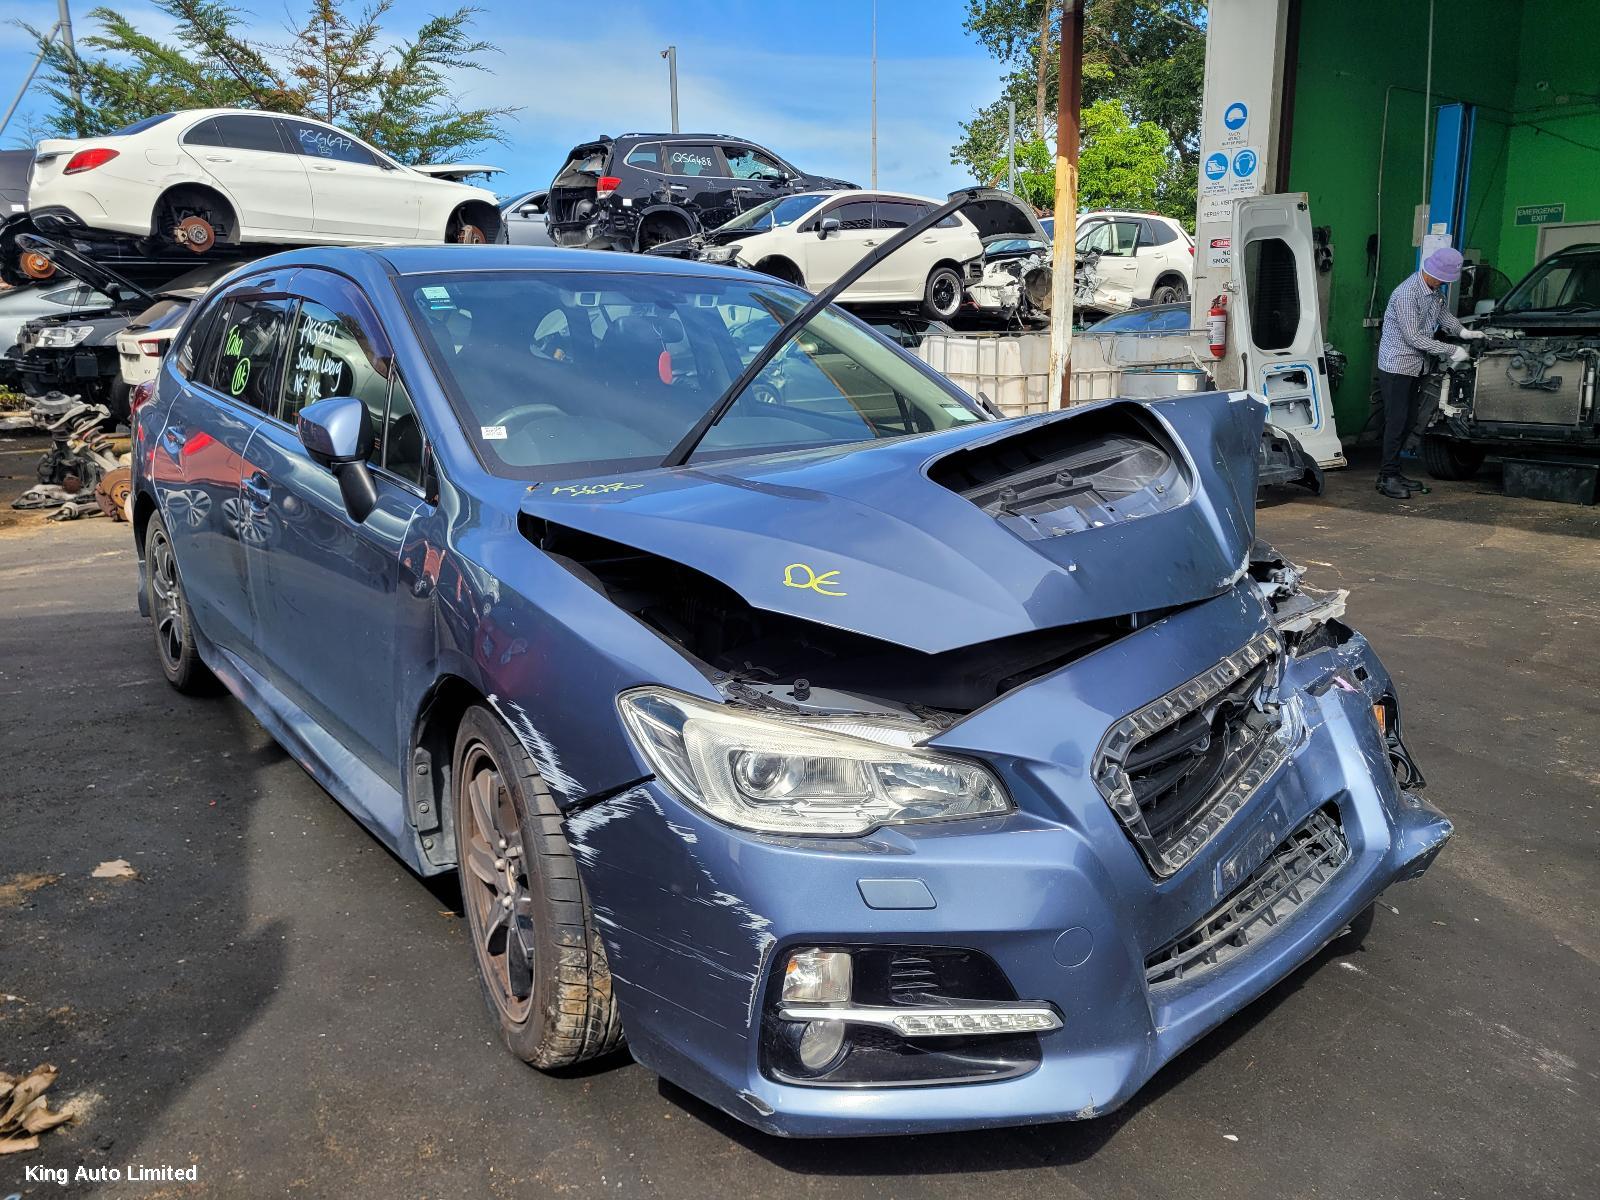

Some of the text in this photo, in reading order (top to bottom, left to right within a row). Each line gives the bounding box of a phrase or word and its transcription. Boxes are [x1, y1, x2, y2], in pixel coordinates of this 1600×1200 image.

[672, 152, 712, 166] QSG488
[1517, 206, 1562, 216] EMERGENCY
[1531, 214, 1547, 222] EXIT
